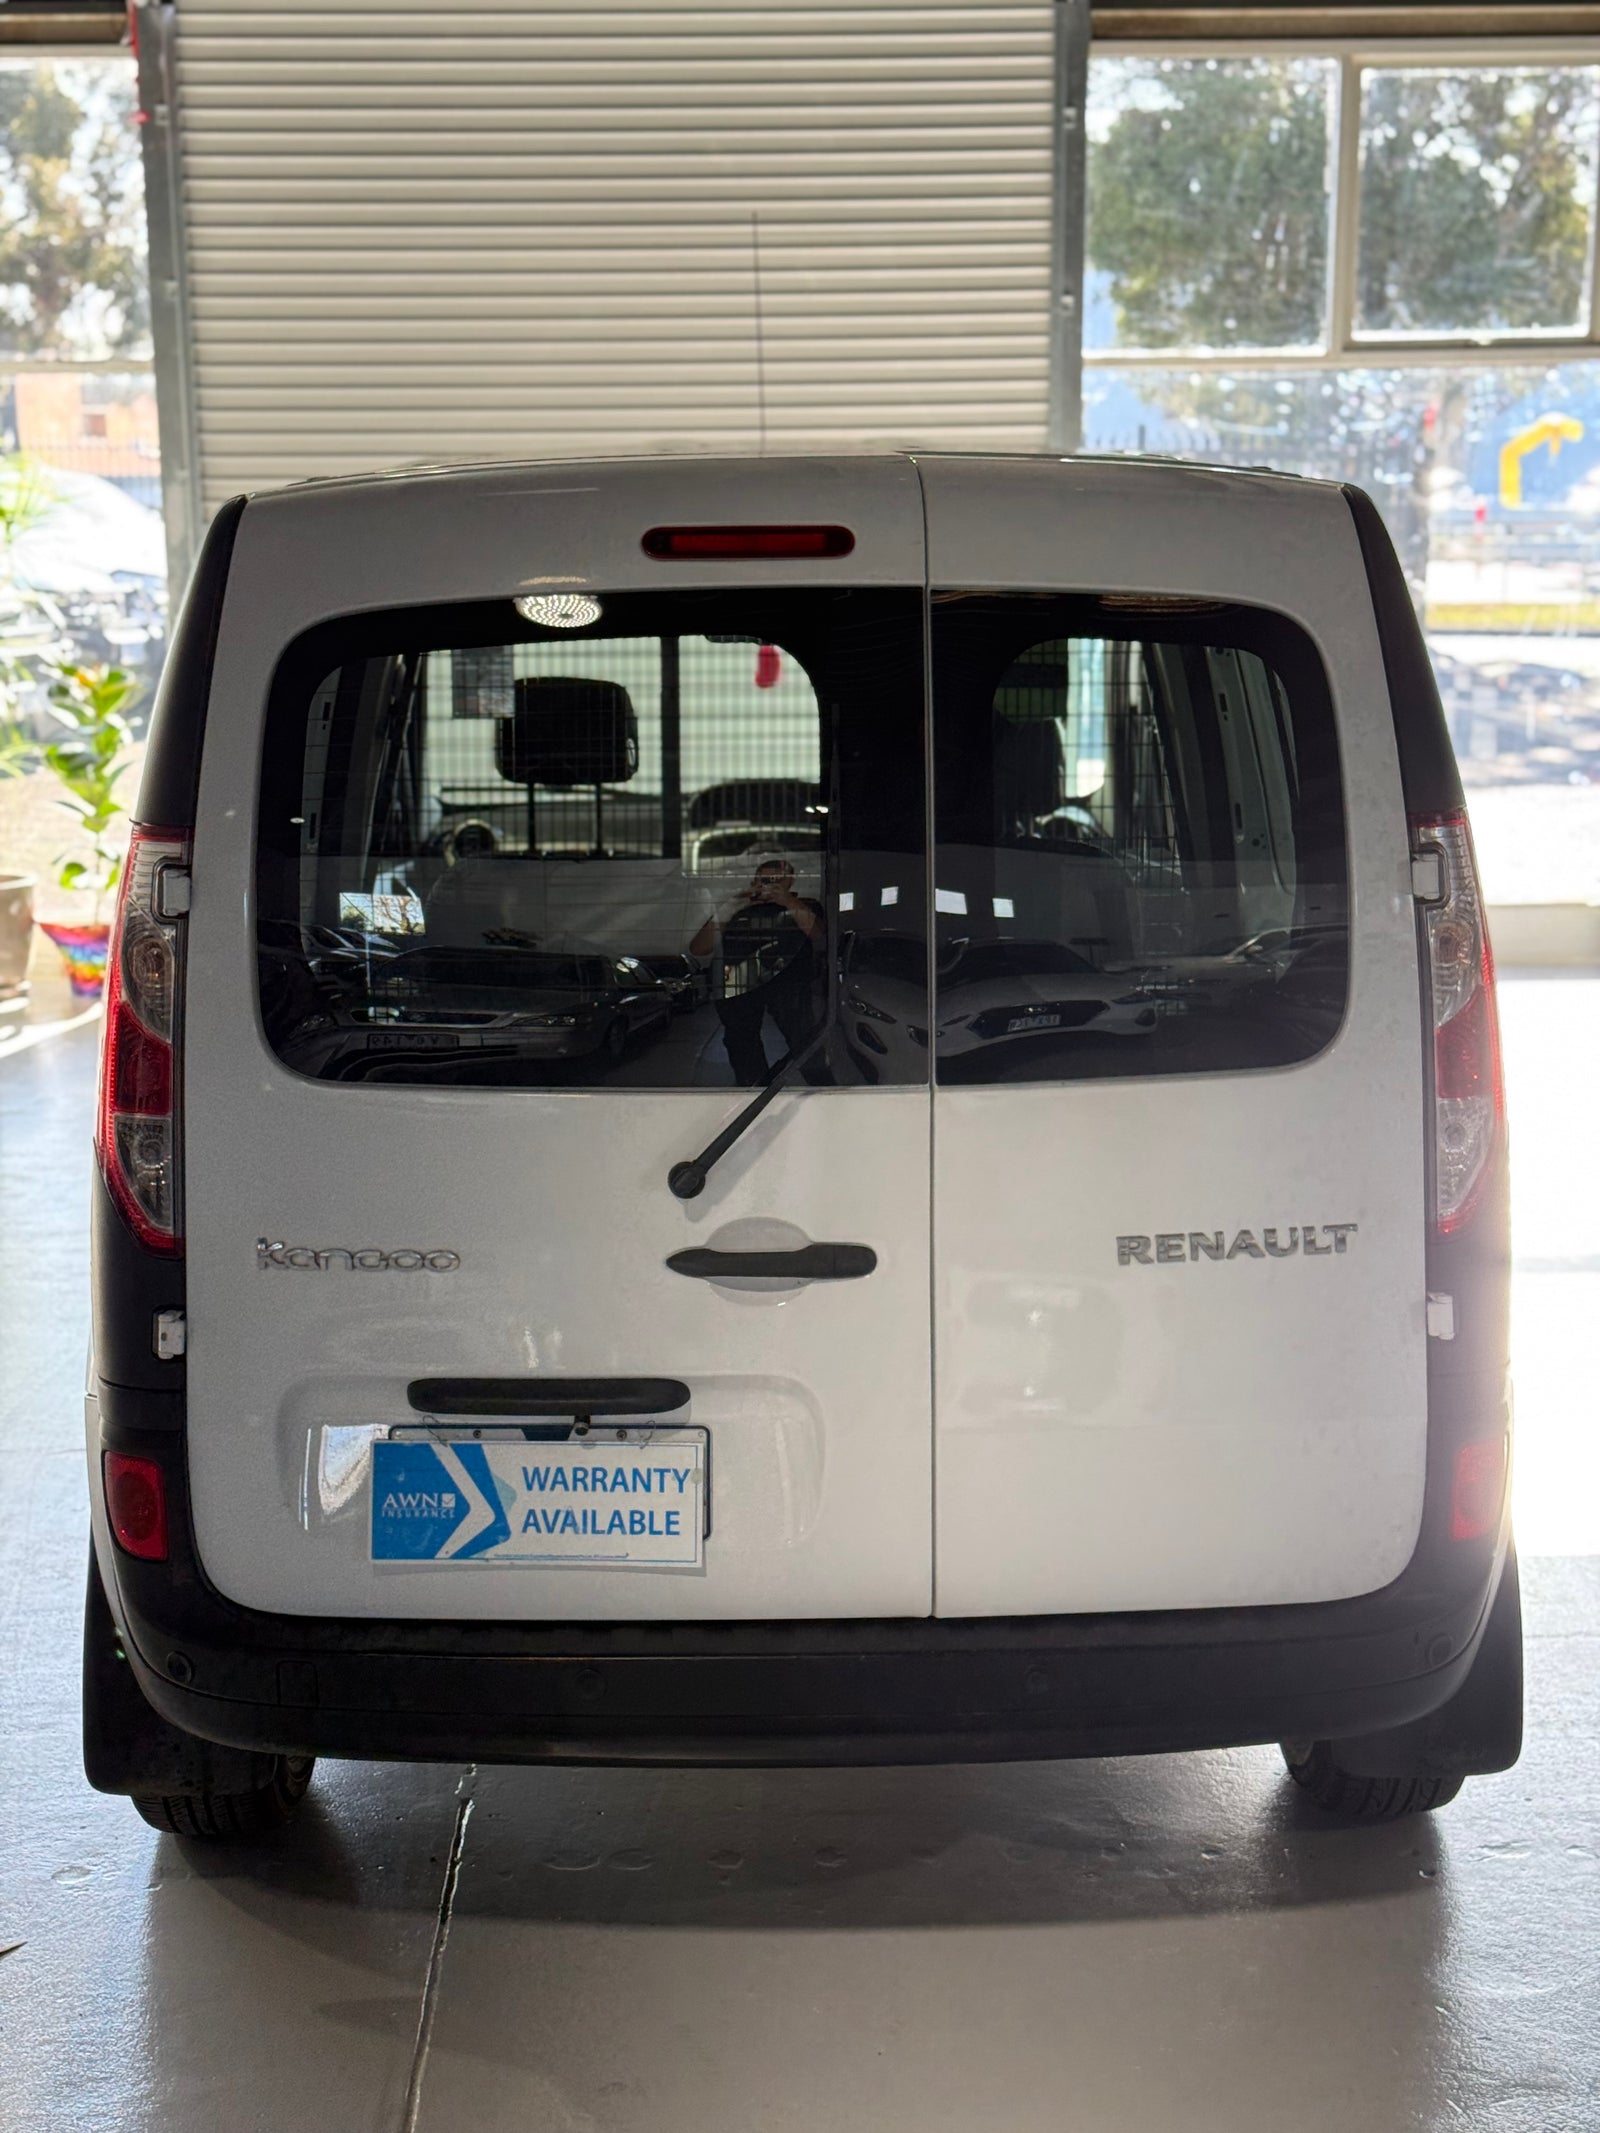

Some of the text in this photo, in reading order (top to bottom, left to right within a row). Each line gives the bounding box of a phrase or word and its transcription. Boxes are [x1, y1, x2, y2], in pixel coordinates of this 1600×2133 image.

[1116, 1223, 1358, 1266] RENAULT
[521, 1466, 691, 1494] WARRANTY
[381, 1508, 456, 1518] INSURANCE
[382, 1492, 439, 1508] AWN
[521, 1509, 681, 1536] AVAILABLE
